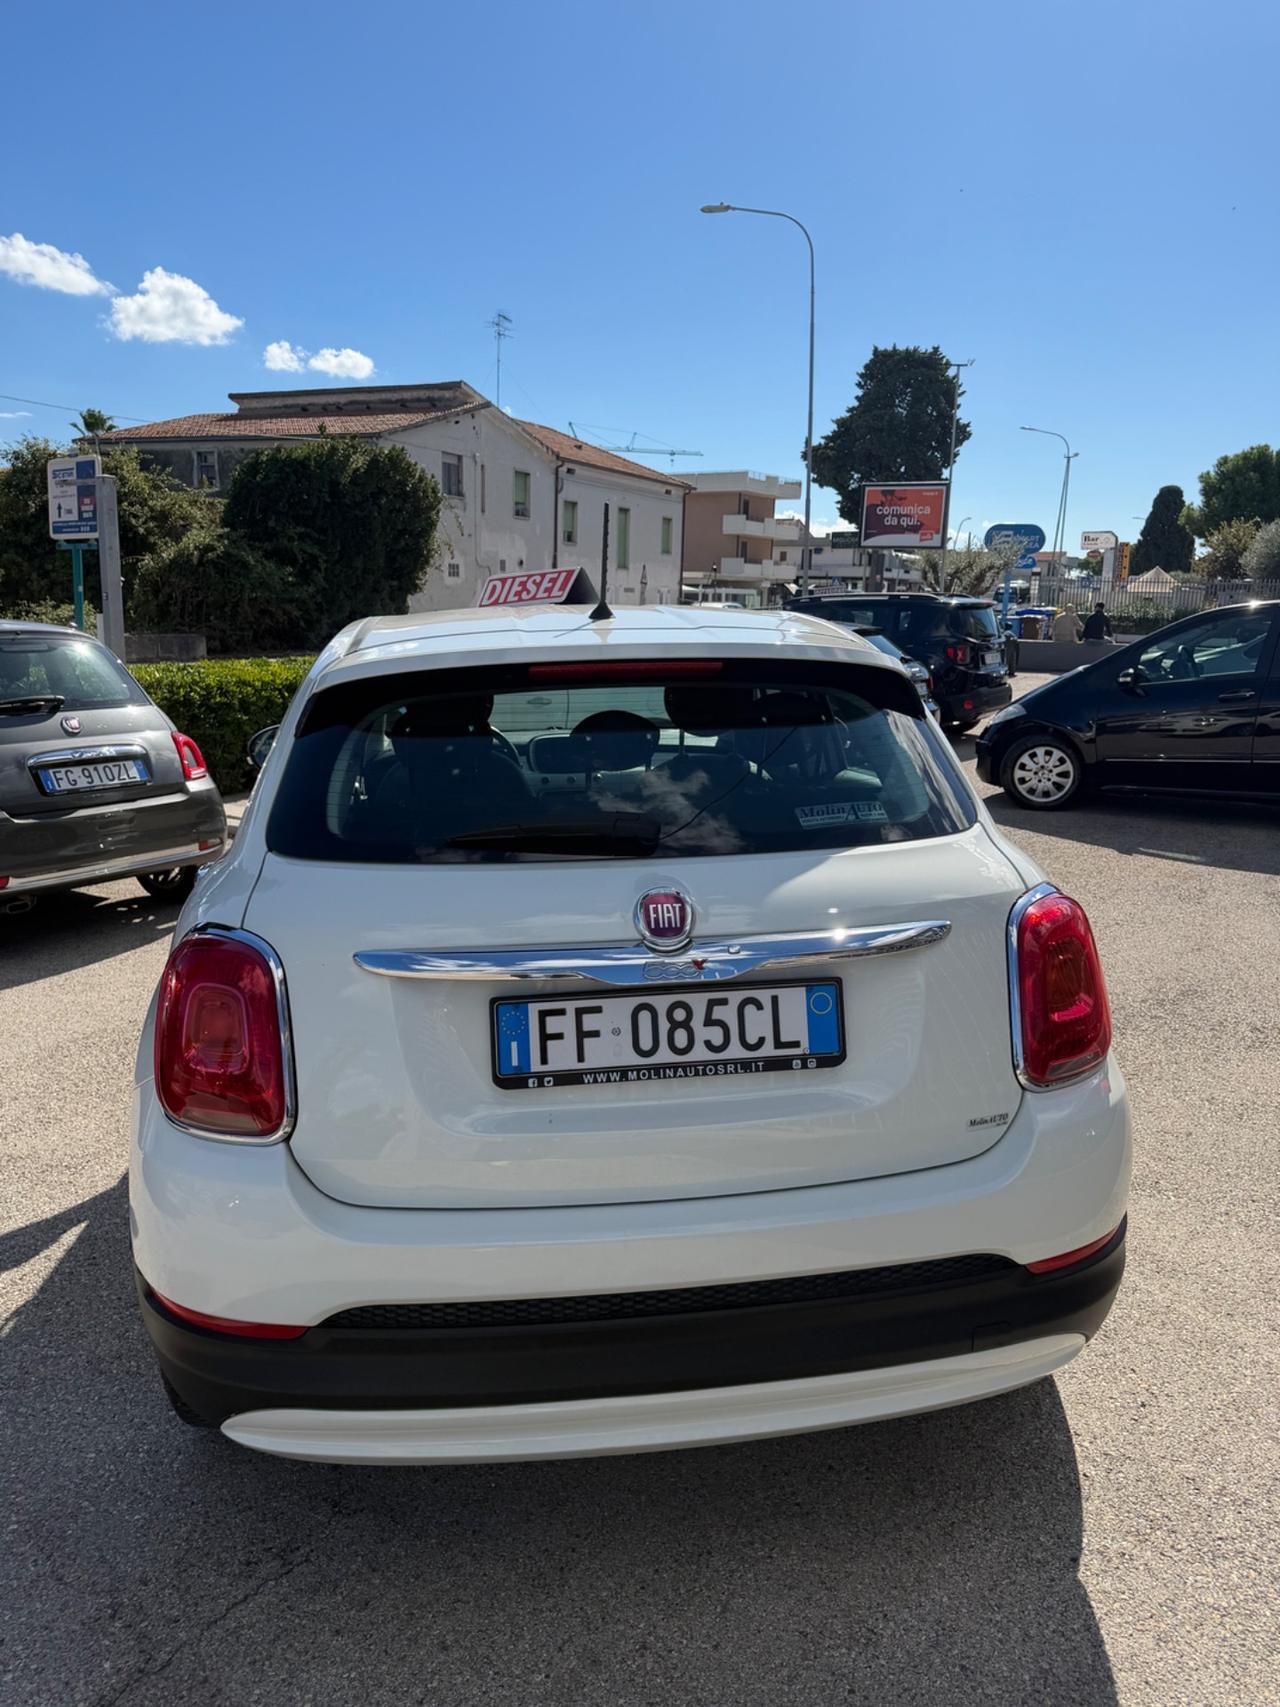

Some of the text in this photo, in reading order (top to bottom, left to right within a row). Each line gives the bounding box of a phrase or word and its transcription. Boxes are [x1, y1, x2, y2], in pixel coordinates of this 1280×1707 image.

[876, 504, 931, 515] comunica
[884, 515, 920, 529] da qui.
[481, 572, 568, 605] DIESEL
[649, 903, 682, 929] FIAT
[631, 995, 802, 1058] 085CL
[582, 1062, 766, 1085] WWW.MOLINAUTOSRL.IT
